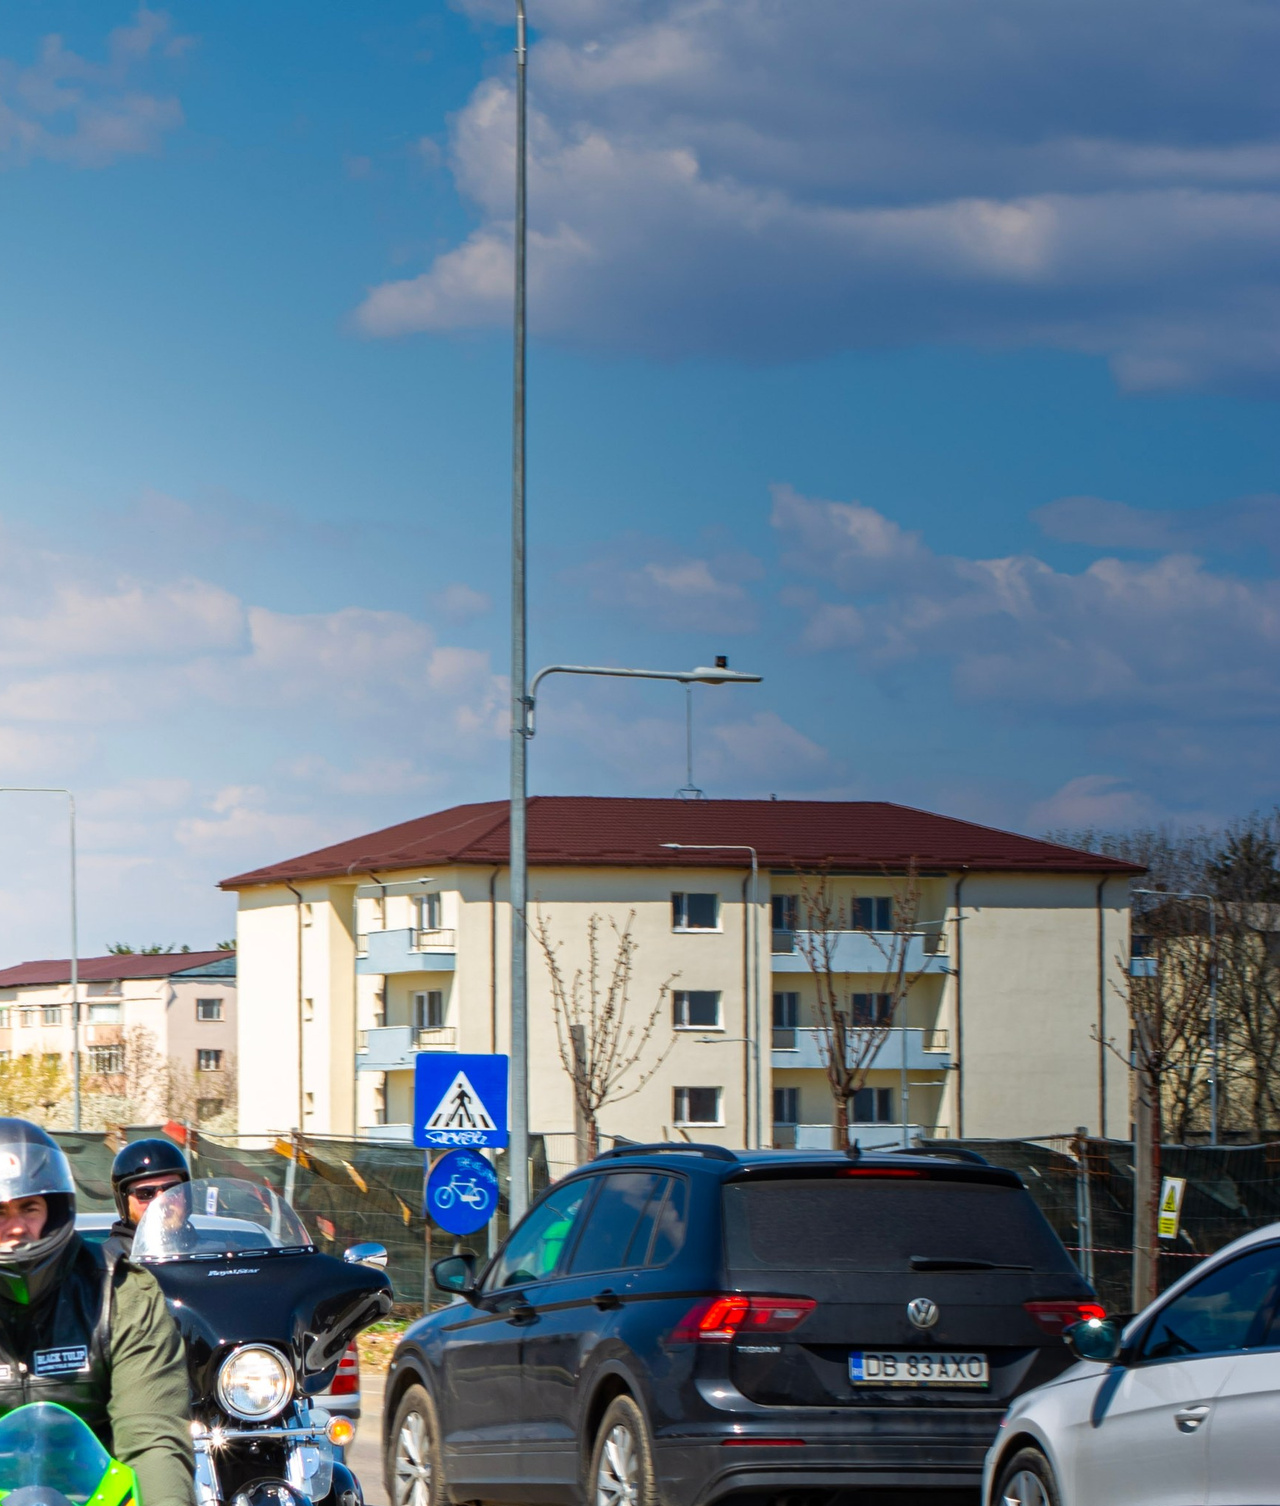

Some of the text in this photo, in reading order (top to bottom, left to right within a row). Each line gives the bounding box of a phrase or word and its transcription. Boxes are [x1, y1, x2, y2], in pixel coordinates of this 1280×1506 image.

[37, 1353, 61, 1365] BLACK
[62, 1351, 85, 1361] TULIP
[865, 1354, 984, 1378] DB 83 AXO
